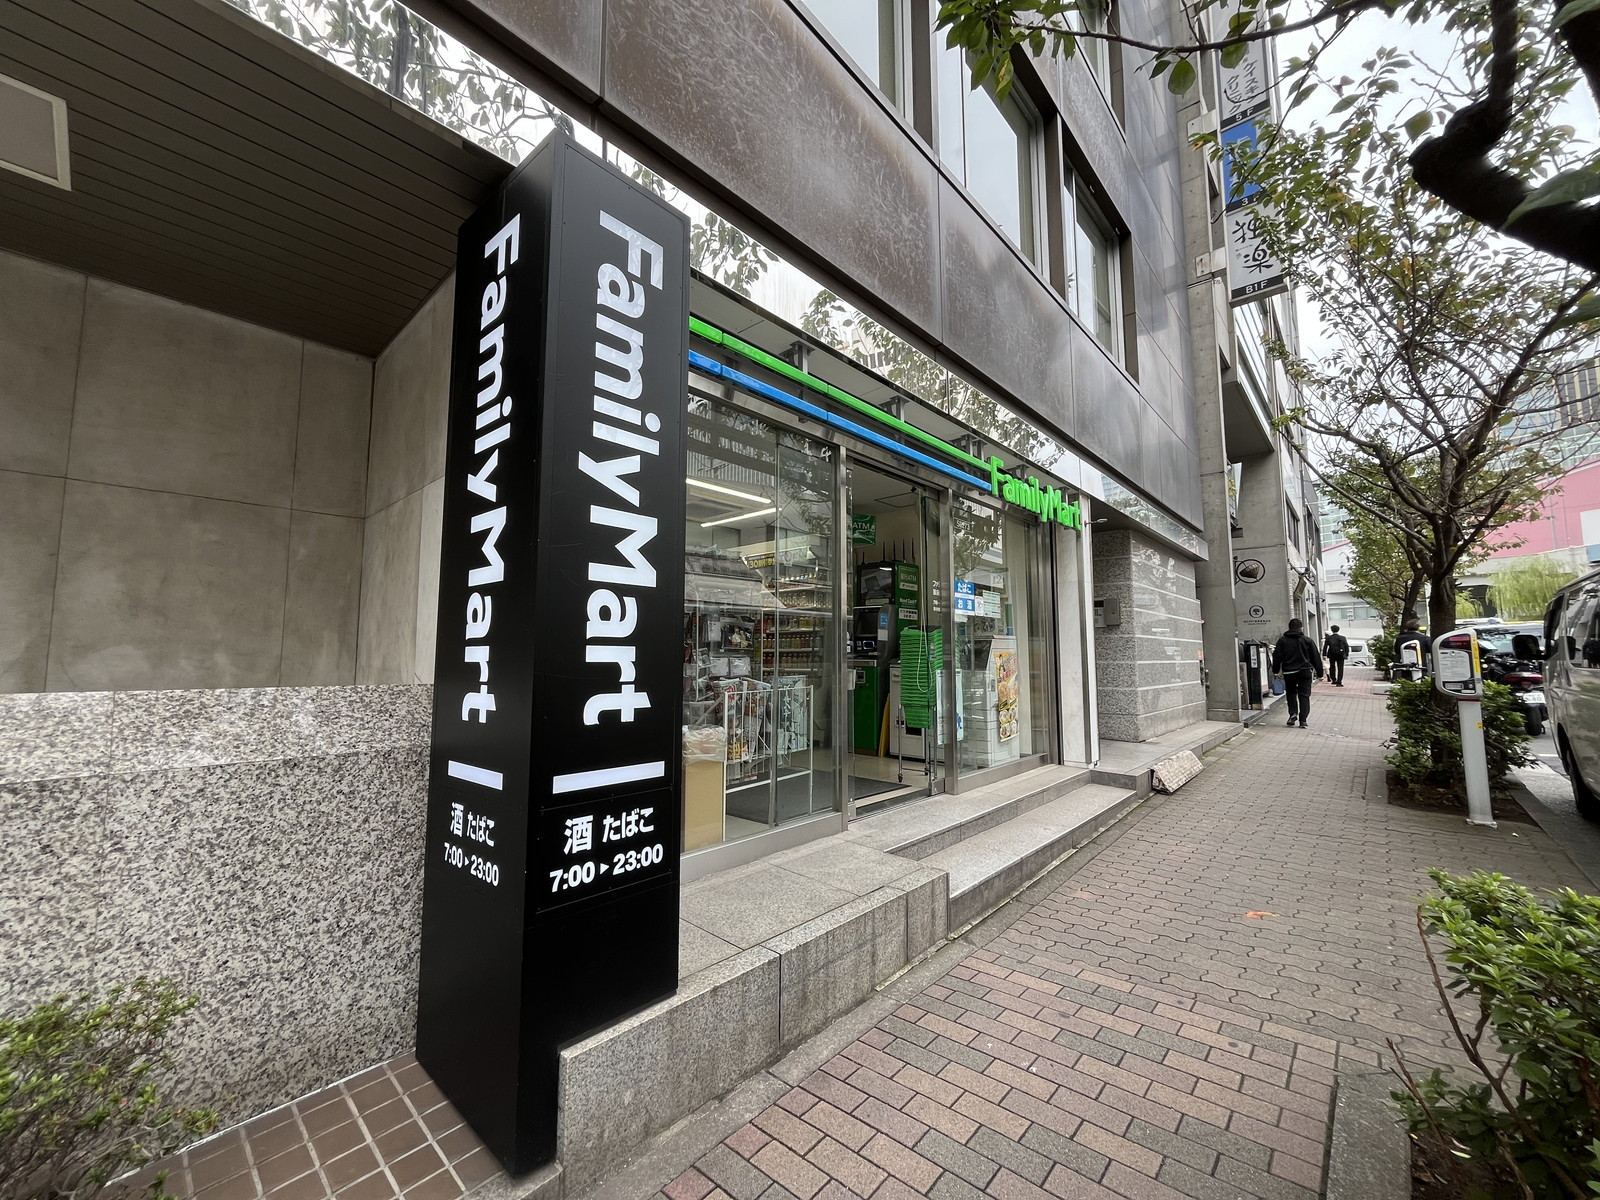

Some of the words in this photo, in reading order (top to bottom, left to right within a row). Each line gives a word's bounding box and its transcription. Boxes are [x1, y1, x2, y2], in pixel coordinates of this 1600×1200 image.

[1245, 280, 1268, 294] B1F
[461, 213, 521, 724] FamilyMart
[578, 209, 664, 726] FamilyMart
[990, 455, 1082, 531] FamilyMart
[853, 522, 870, 530] ATM
[957, 582, 972, 594] たばこ
[450, 802, 464, 838] 酒
[466, 811, 495, 847] たばこ
[563, 815, 594, 855] 酒
[602, 807, 655, 843] たばこ
[444, 842, 463, 869] 7:00
[470, 854, 500, 887] 23:00
[550, 861, 596, 893] 7:00
[612, 843, 664, 876] 23:00
